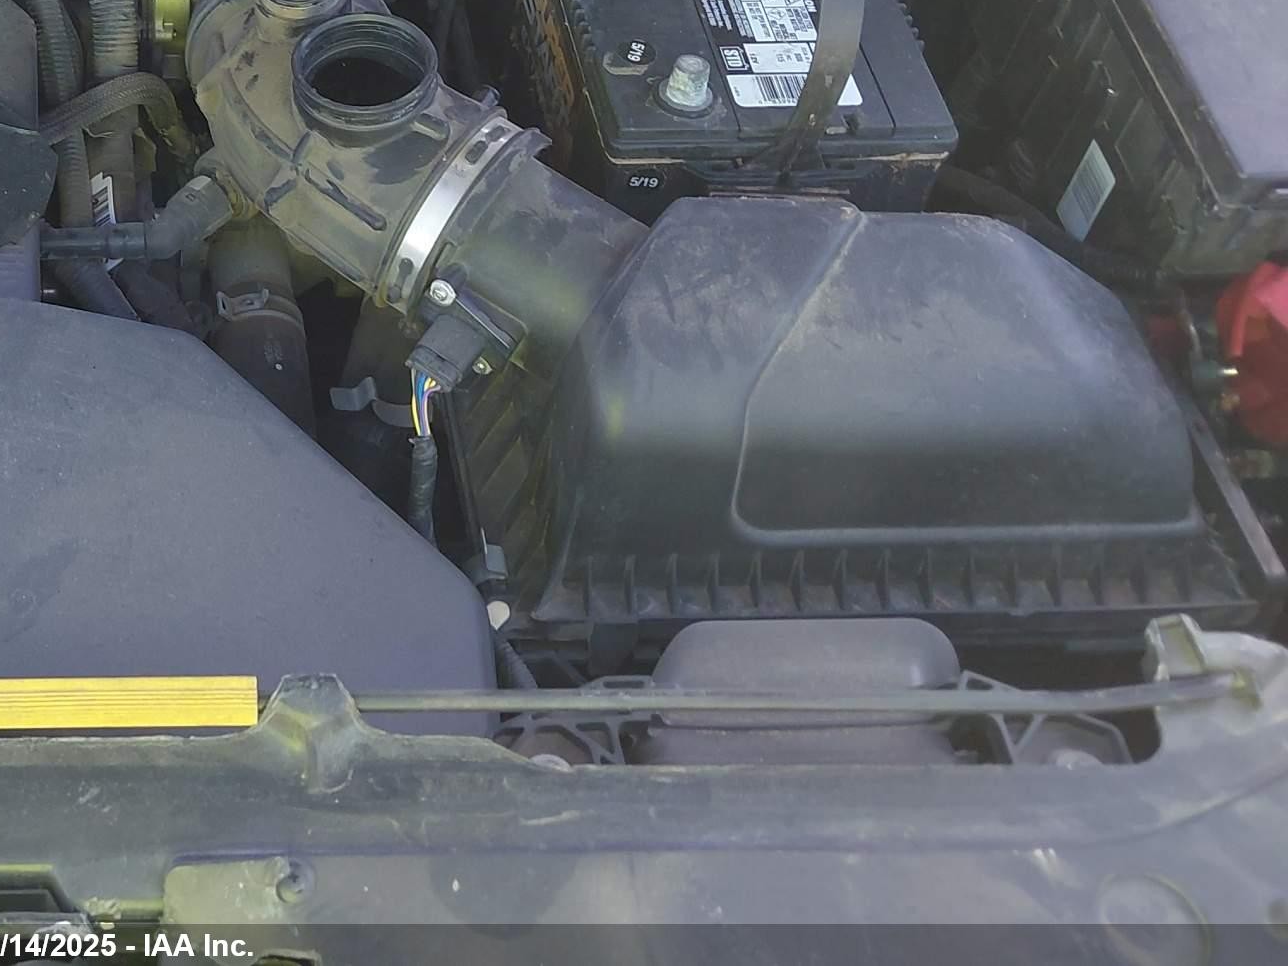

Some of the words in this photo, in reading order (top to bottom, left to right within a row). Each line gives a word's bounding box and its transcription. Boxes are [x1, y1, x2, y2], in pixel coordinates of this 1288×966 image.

[627, 41, 645, 62] 5/19
[723, 49, 744, 67] STD
[628, 177, 659, 189] 5/19
